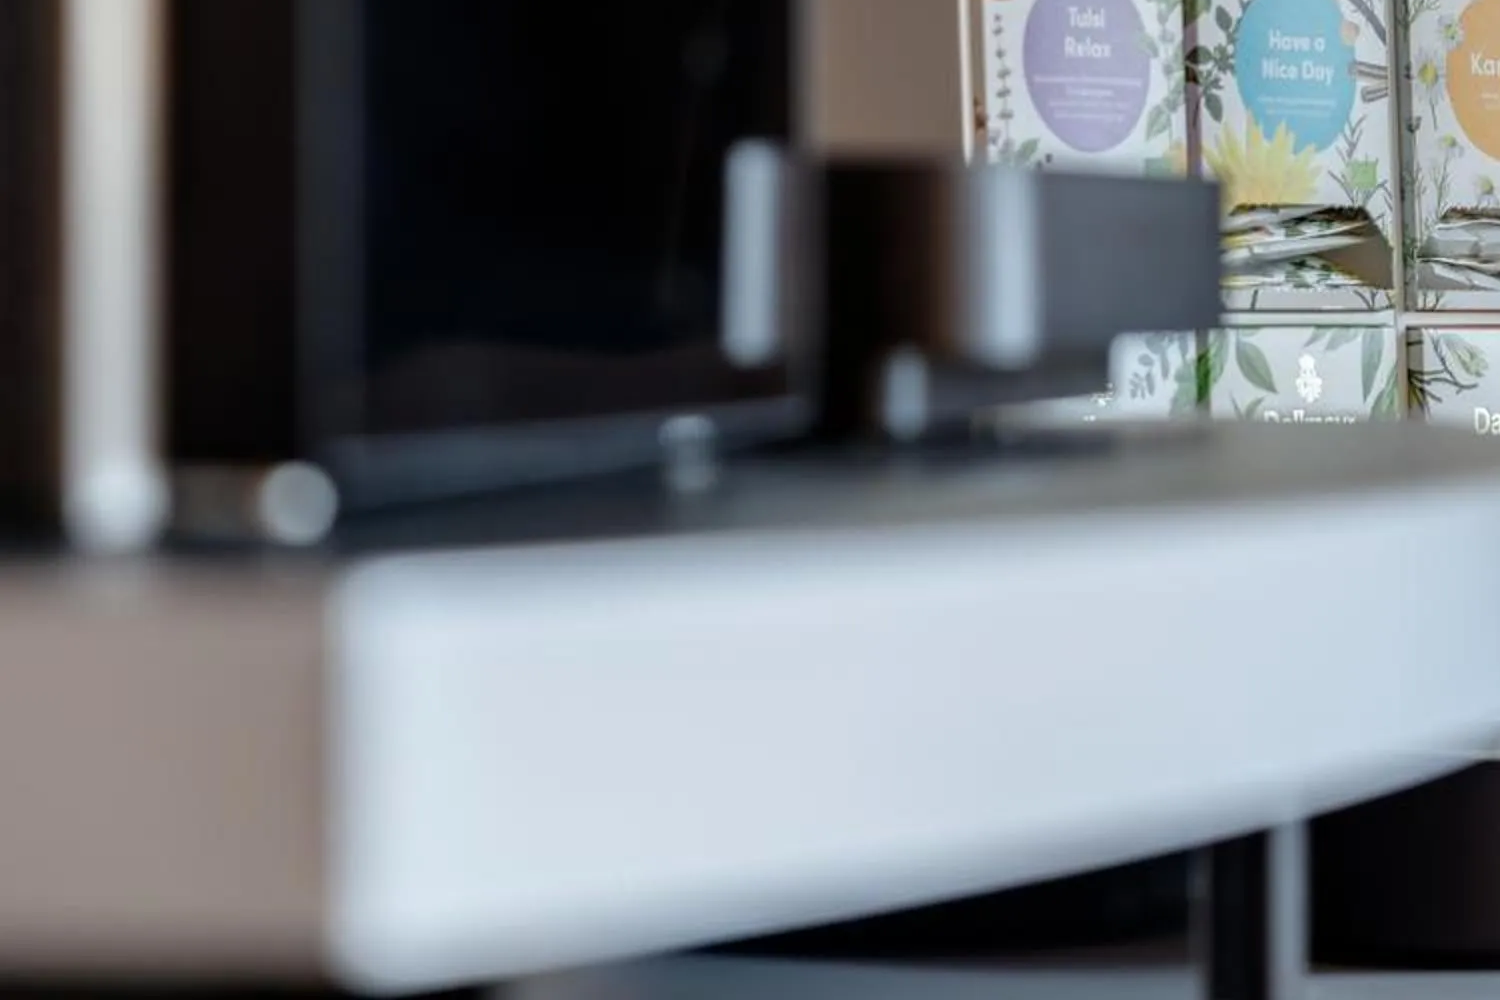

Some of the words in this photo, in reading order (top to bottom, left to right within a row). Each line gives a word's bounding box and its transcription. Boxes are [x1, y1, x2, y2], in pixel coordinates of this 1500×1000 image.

[1064, 35, 1111, 58] Relax
[1268, 28, 1309, 52] Have
[1315, 39, 1325, 53] a
[1262, 59, 1299, 80] Nice
[1302, 61, 1334, 87] Day
